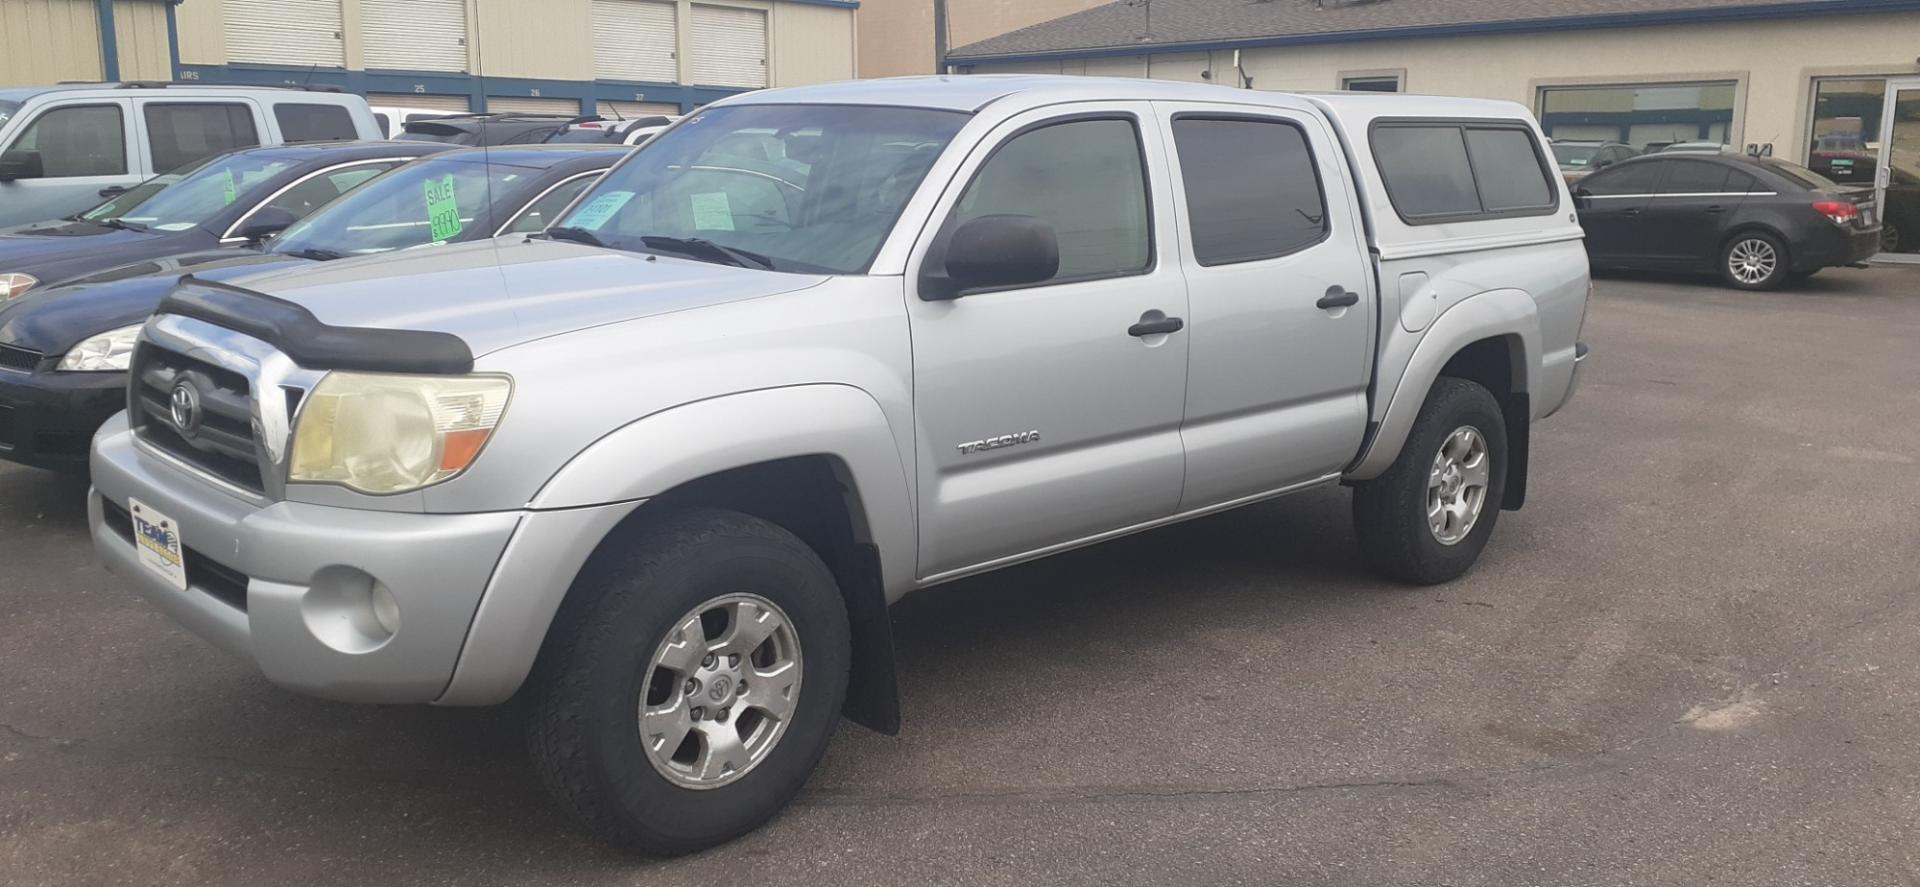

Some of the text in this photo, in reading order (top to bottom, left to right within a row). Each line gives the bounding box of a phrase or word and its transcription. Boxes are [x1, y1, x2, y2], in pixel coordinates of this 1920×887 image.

[414, 84, 425, 93] 25
[530, 88, 540, 97] 26
[635, 93, 645, 101] 27
[427, 183, 451, 206] SALE
[957, 429, 1041, 455] TACOMA
[134, 515, 169, 549] TEAM
